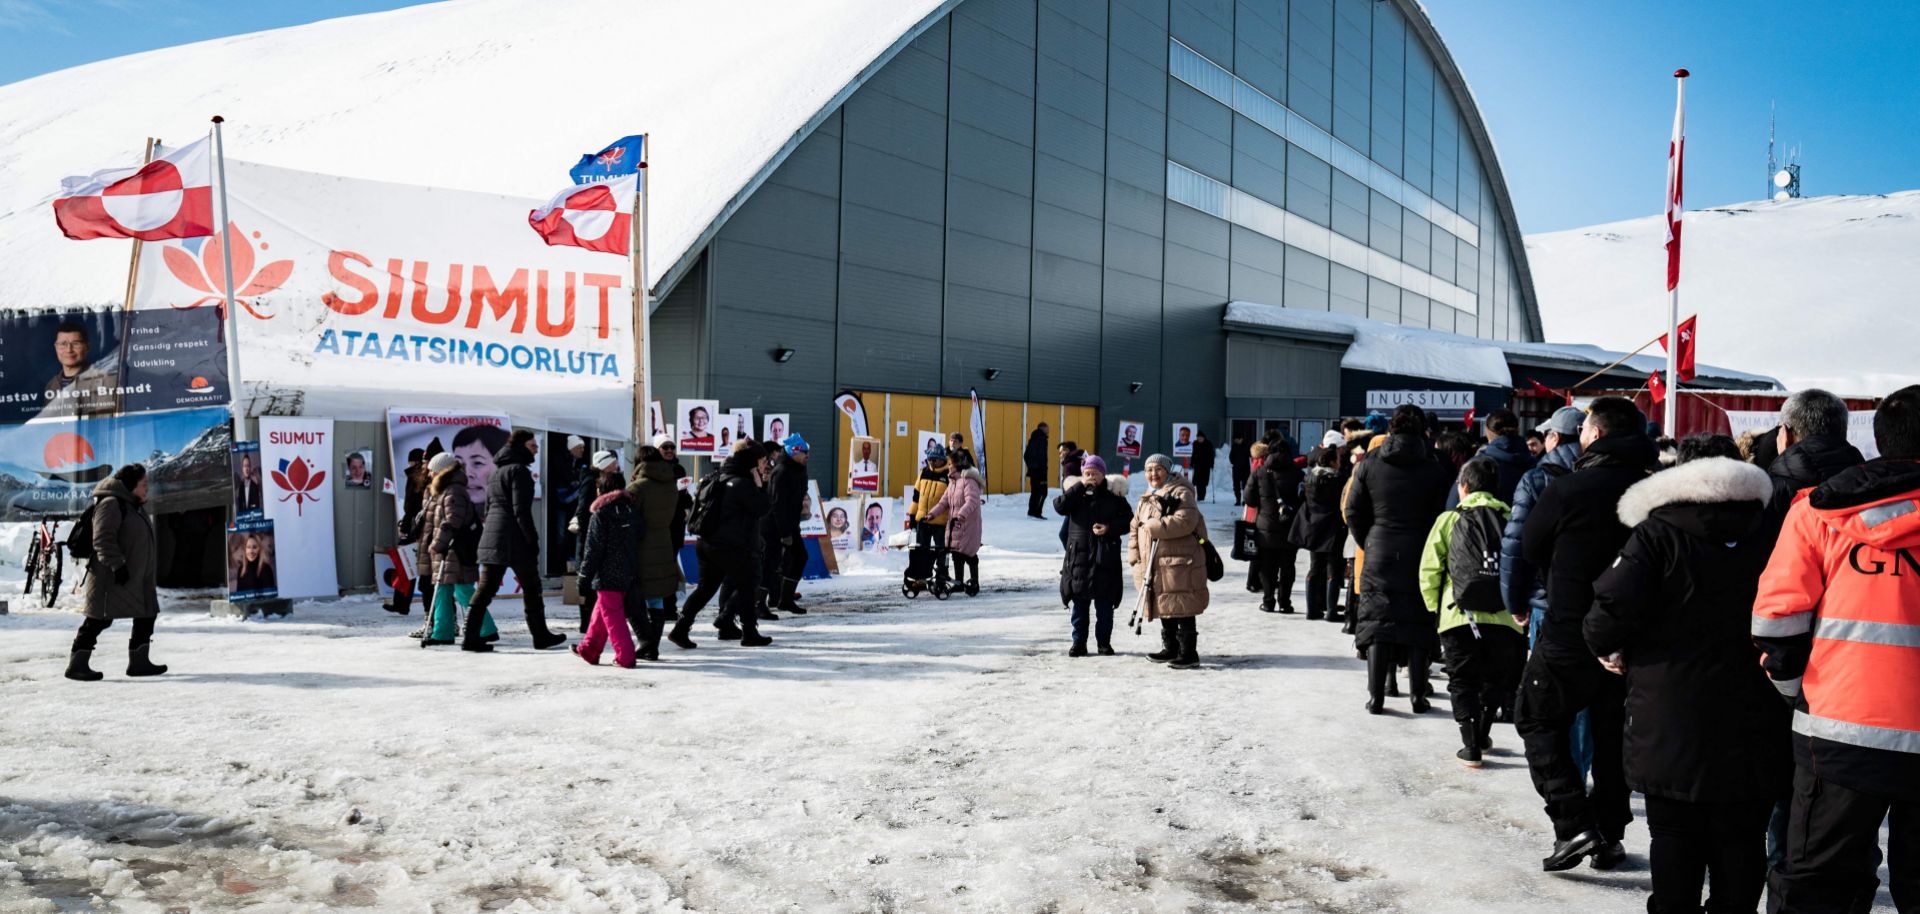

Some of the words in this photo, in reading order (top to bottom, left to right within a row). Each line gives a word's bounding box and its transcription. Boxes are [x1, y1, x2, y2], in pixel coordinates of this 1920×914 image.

[320, 250, 622, 339] SIUMUT
[130, 326, 160, 335] Frihed
[132, 342, 171, 351] Gensidig
[174, 340, 209, 348] respekt
[313, 328, 620, 377] ATAATSIMOORLUTA
[133, 359, 176, 368] Udvikling
[0, 392, 38, 403] ustav
[44, 388, 91, 400] Olsen
[96, 383, 152, 397] Brandt
[1371, 392, 1470, 405] INUSSIVIK
[175, 395, 223, 404] DEMOKRAATIT
[269, 431, 325, 445] SIUMUT
[32, 490, 93, 501] DEMOKRAA
